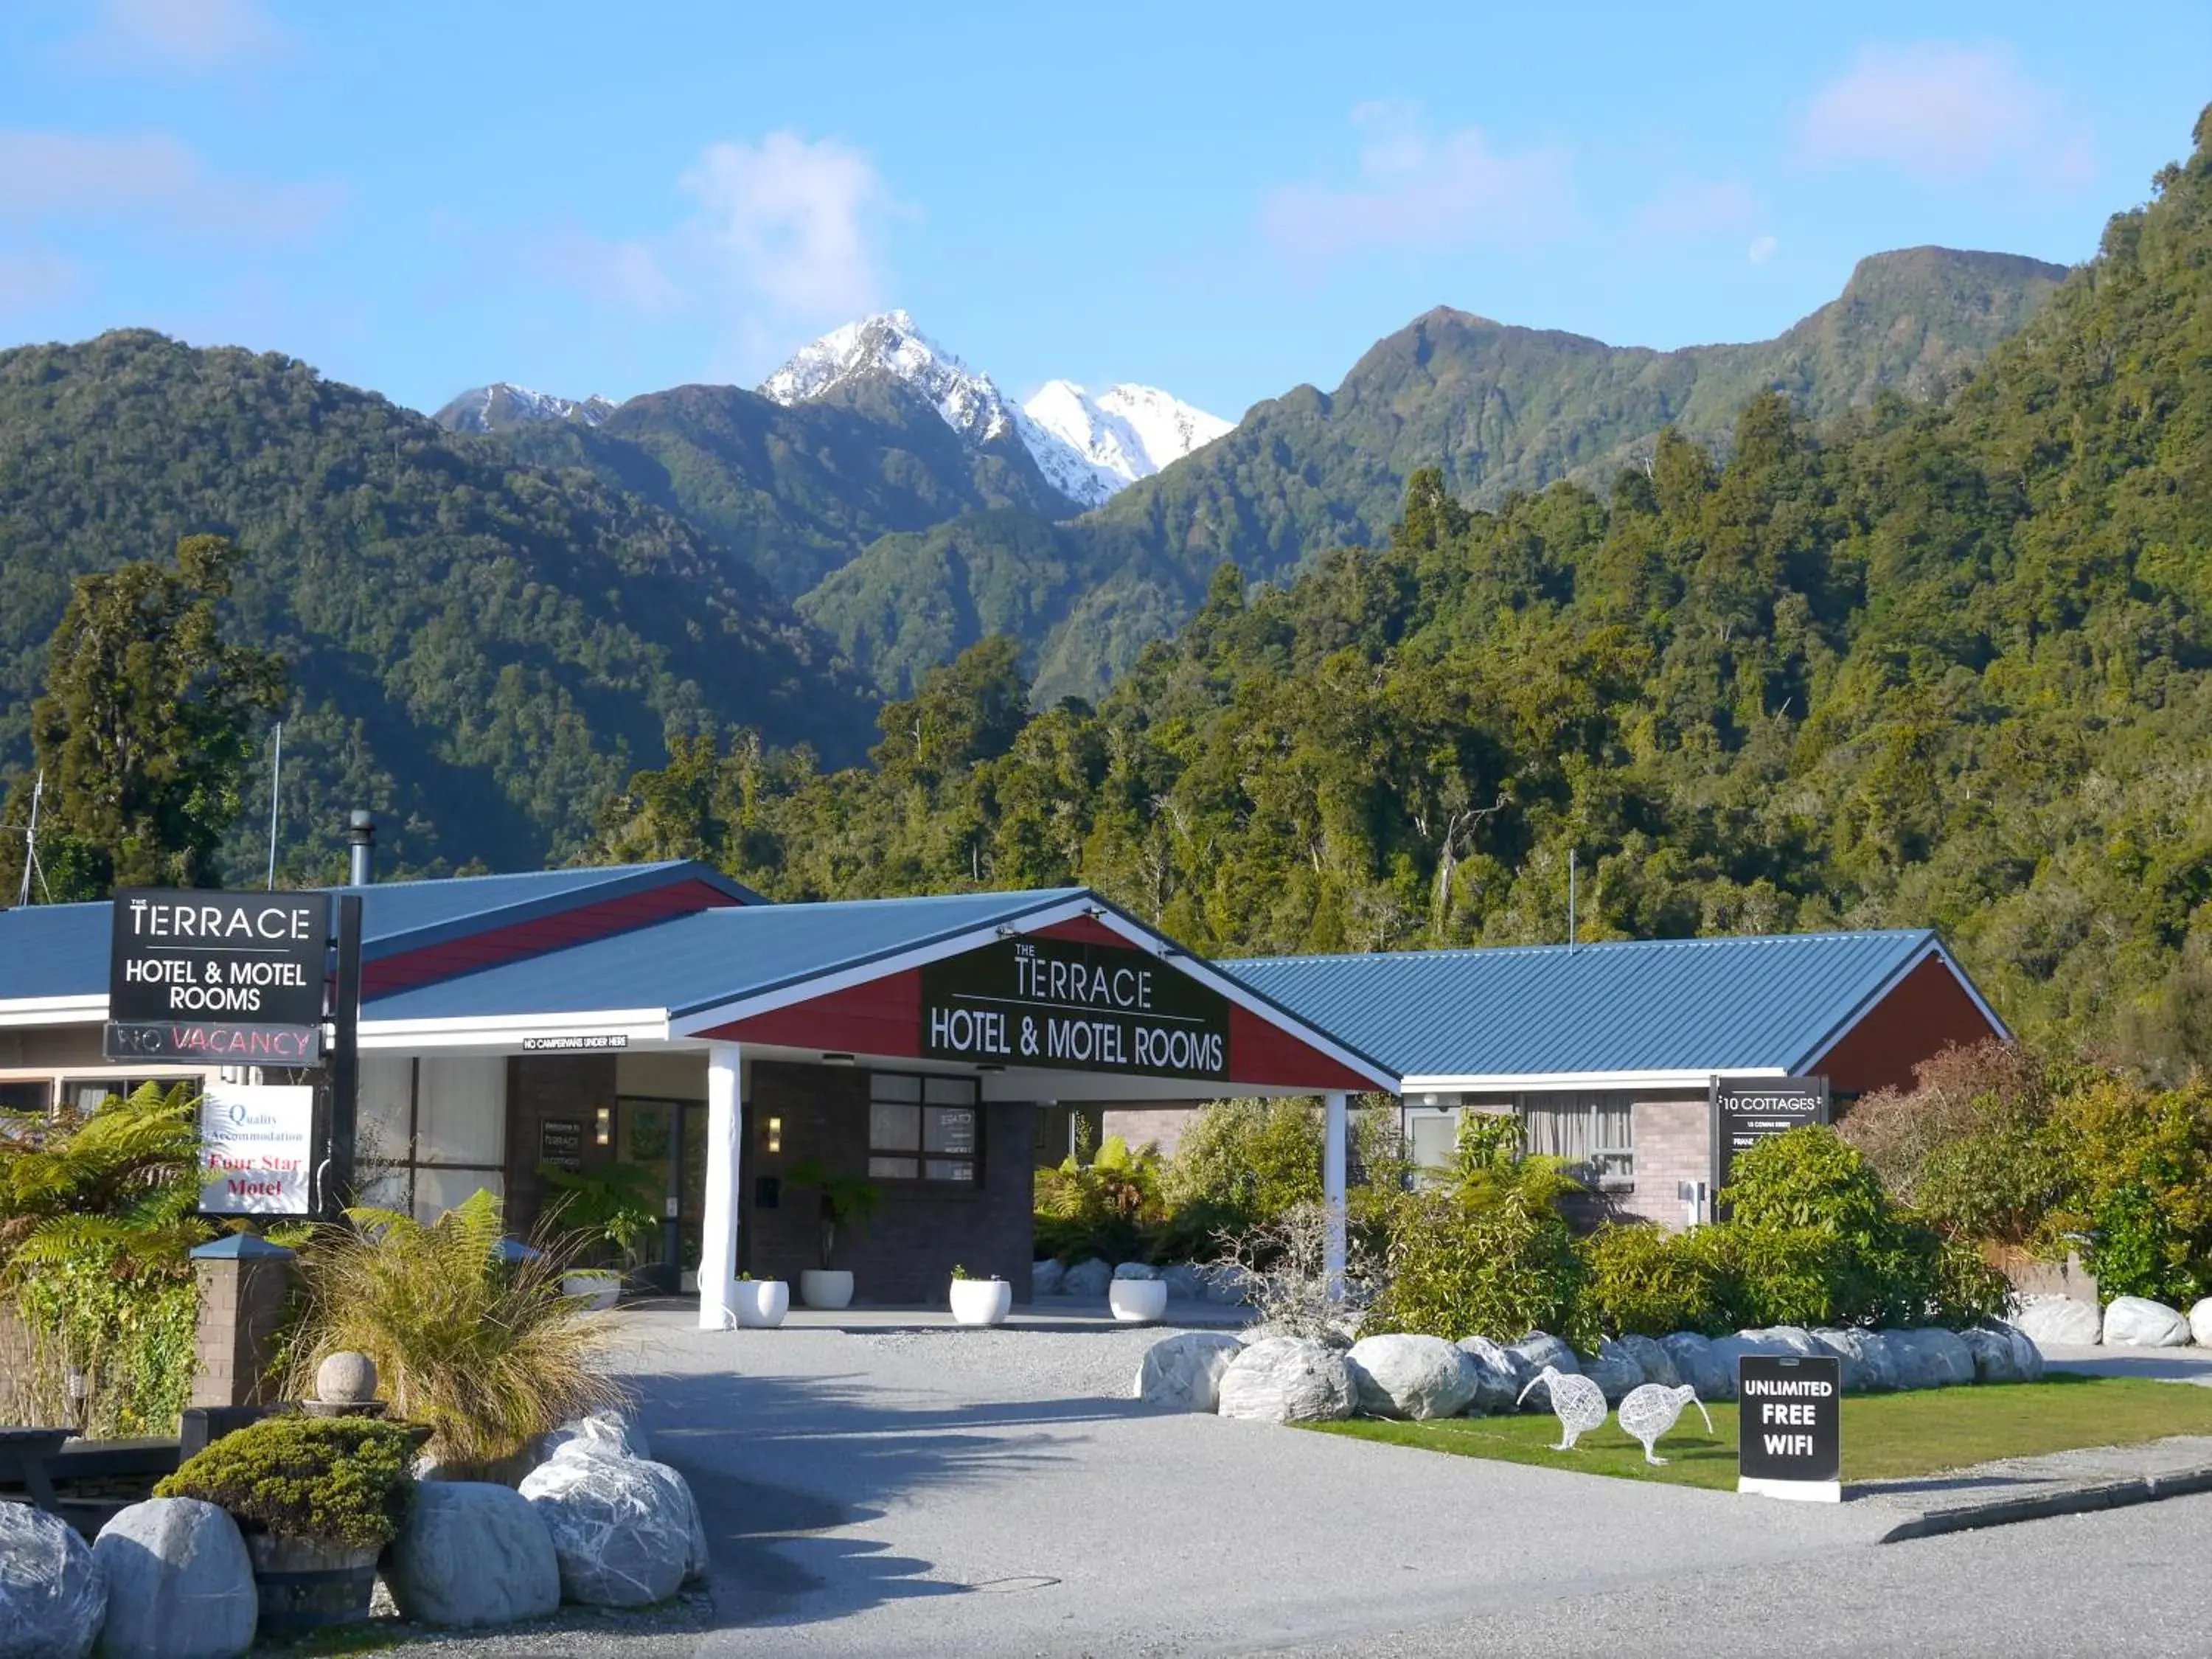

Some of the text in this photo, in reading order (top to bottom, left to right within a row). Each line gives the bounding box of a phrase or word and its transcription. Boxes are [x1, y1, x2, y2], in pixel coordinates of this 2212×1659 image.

[130, 905, 309, 939] TERRACE
[1015, 943, 1034, 956] THE
[126, 959, 307, 987] HOTEL & MOTEL
[1015, 957, 1152, 1009] TERRACE
[170, 987, 260, 1011] ROOMS
[171, 1026, 310, 1056] VACANCY
[524, 1040, 536, 1048] NO
[583, 1037, 608, 1047] UNDER
[931, 1006, 1222, 1072] HOTEL & MOTEL ROOMS
[1724, 1098, 1815, 1110] 10 COTTAGES
[229, 1105, 277, 1127] Quality
[209, 1154, 302, 1170] Four Star
[228, 1179, 282, 1195] Motel
[1745, 1380, 1832, 1397] UNLIMITED
[1762, 1404, 1816, 1425] FREE
[1764, 1434, 1814, 1456] WIFI
